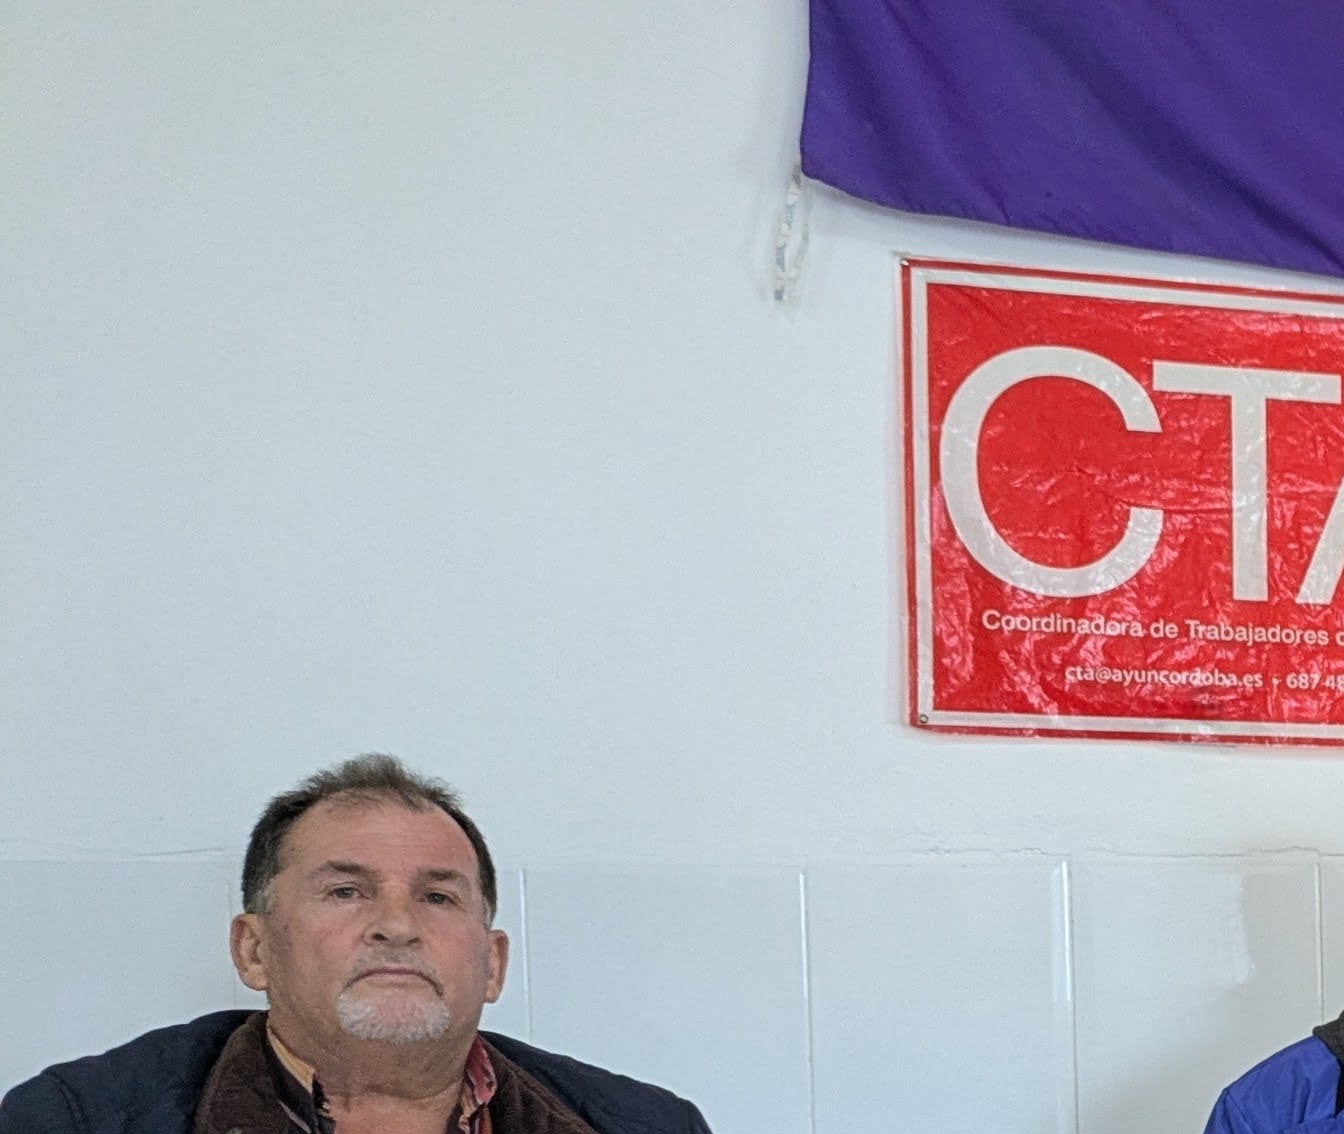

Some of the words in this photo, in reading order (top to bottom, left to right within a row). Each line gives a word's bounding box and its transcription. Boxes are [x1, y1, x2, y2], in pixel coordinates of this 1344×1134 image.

[982, 609, 1145, 638] Coordinadora
[1149, 620, 1179, 639] de
[1184, 619, 1329, 646] Trabajadores
[1065, 666, 1263, 689] cta@ayuncordoba.es
[1286, 673, 1320, 690] 687
